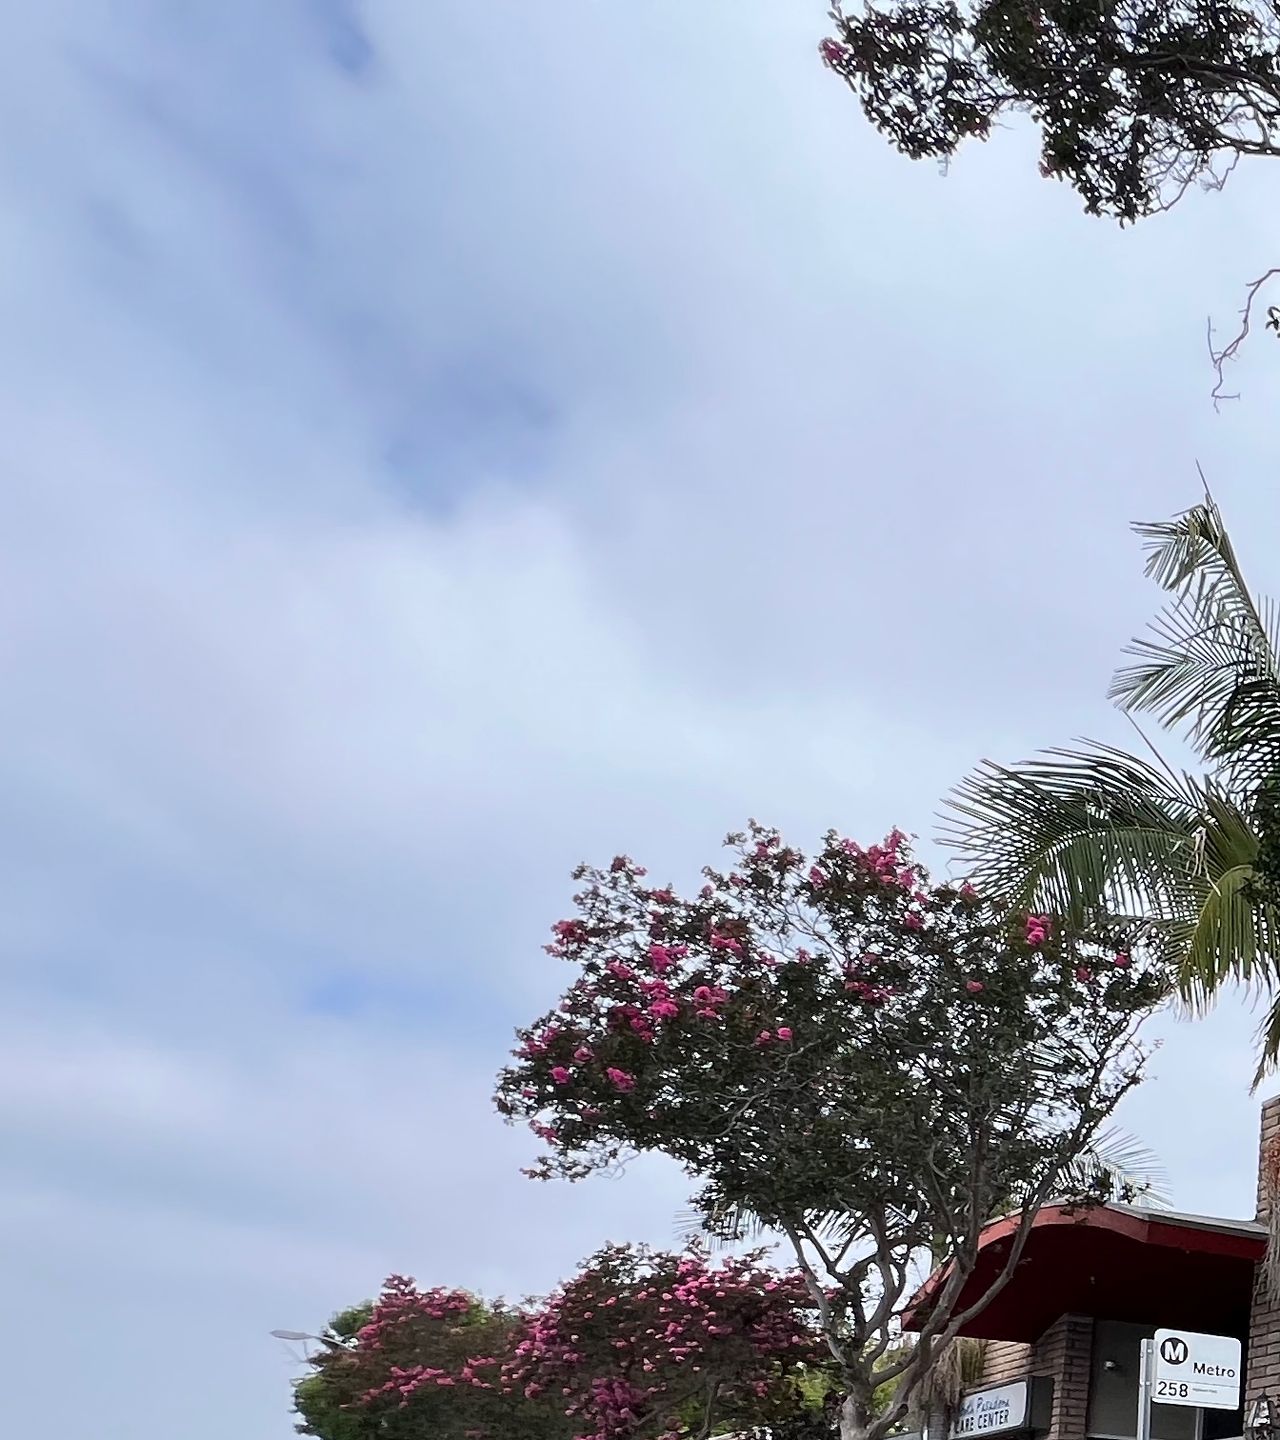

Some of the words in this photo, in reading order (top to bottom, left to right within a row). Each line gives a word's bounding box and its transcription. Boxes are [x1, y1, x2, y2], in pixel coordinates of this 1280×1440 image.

[1164, 1341, 1185, 1361] M
[1193, 1362, 1236, 1378] Metro
[1157, 1381, 1189, 1398] 258
[977, 1409, 1010, 1430] CENTER
